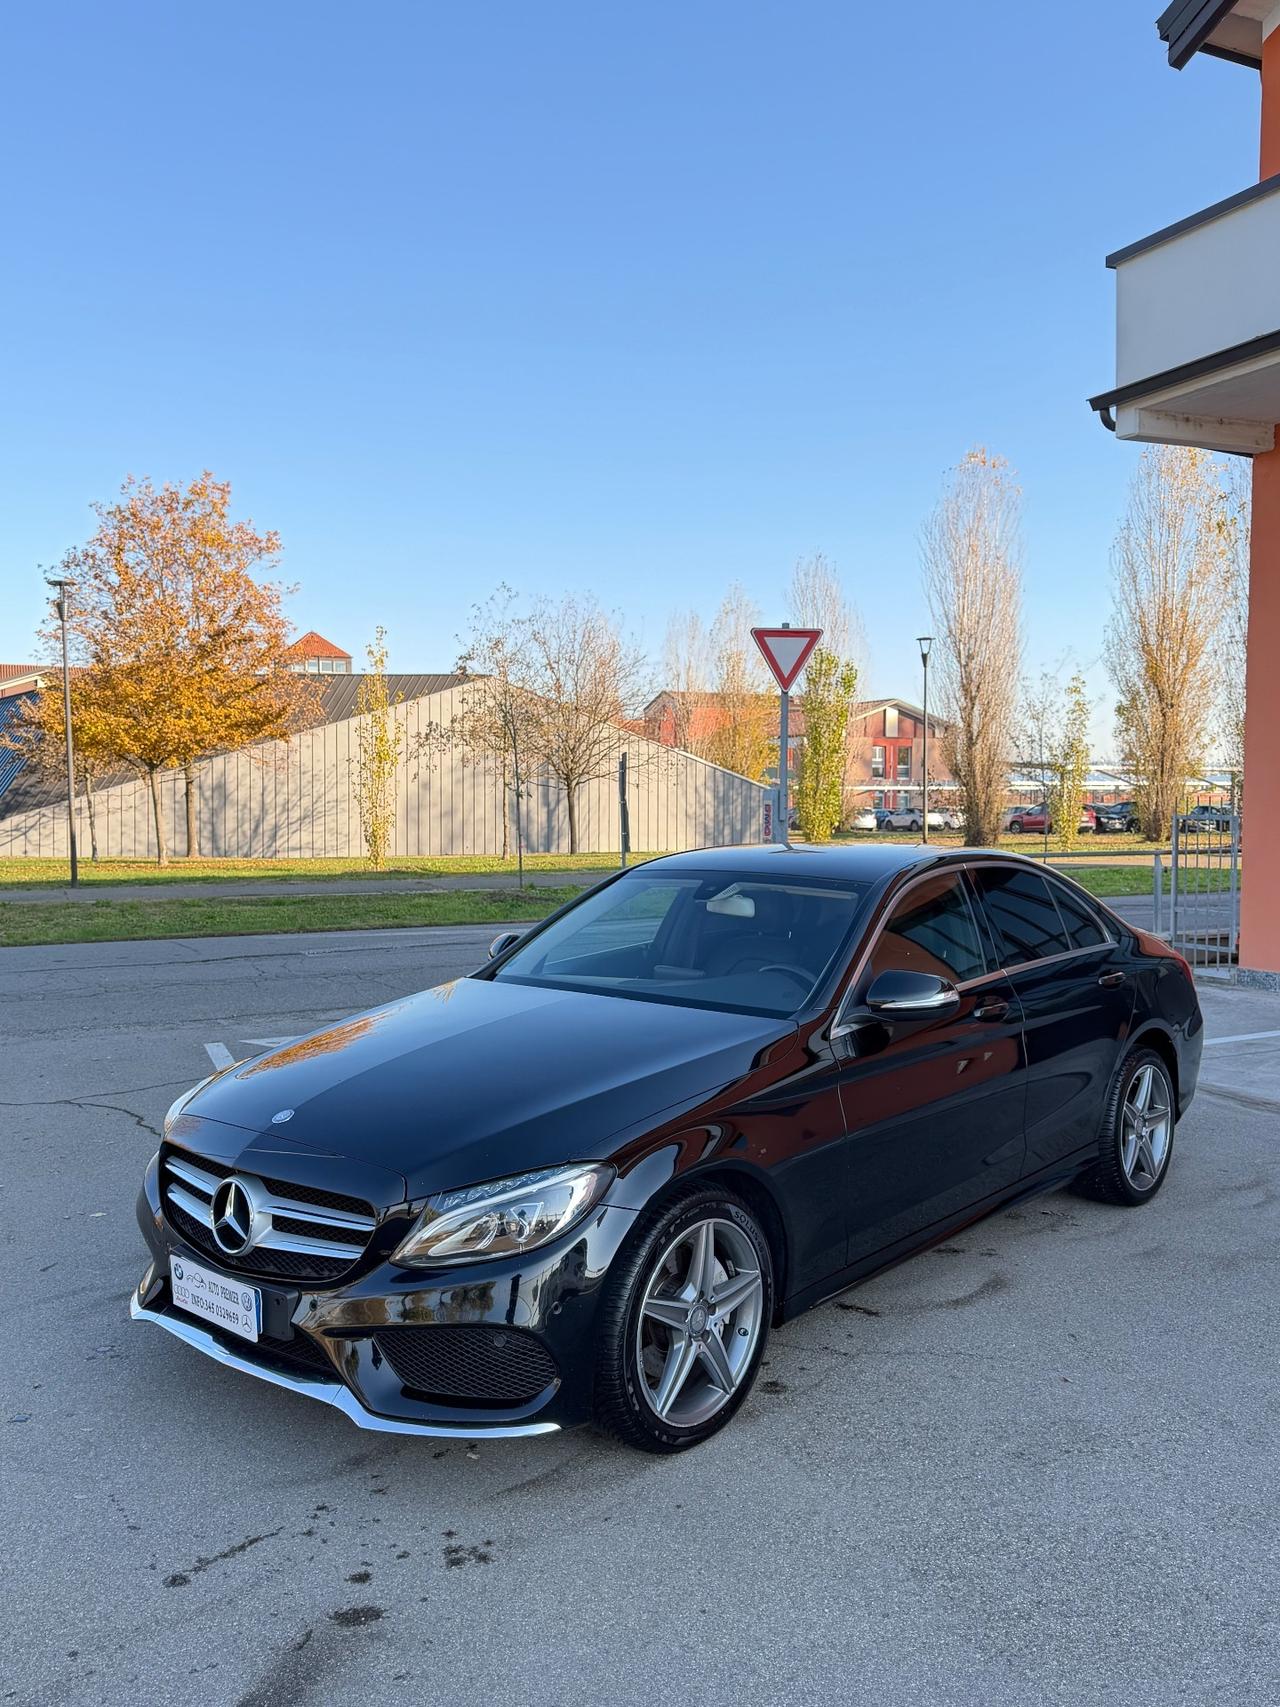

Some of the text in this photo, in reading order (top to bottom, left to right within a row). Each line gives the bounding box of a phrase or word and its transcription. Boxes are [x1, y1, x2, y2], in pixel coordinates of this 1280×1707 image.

[734, 1211, 759, 1241] SOLUS
[208, 1281, 239, 1306] AUTO PREMIER
[215, 1305, 239, 1325] 0329659
